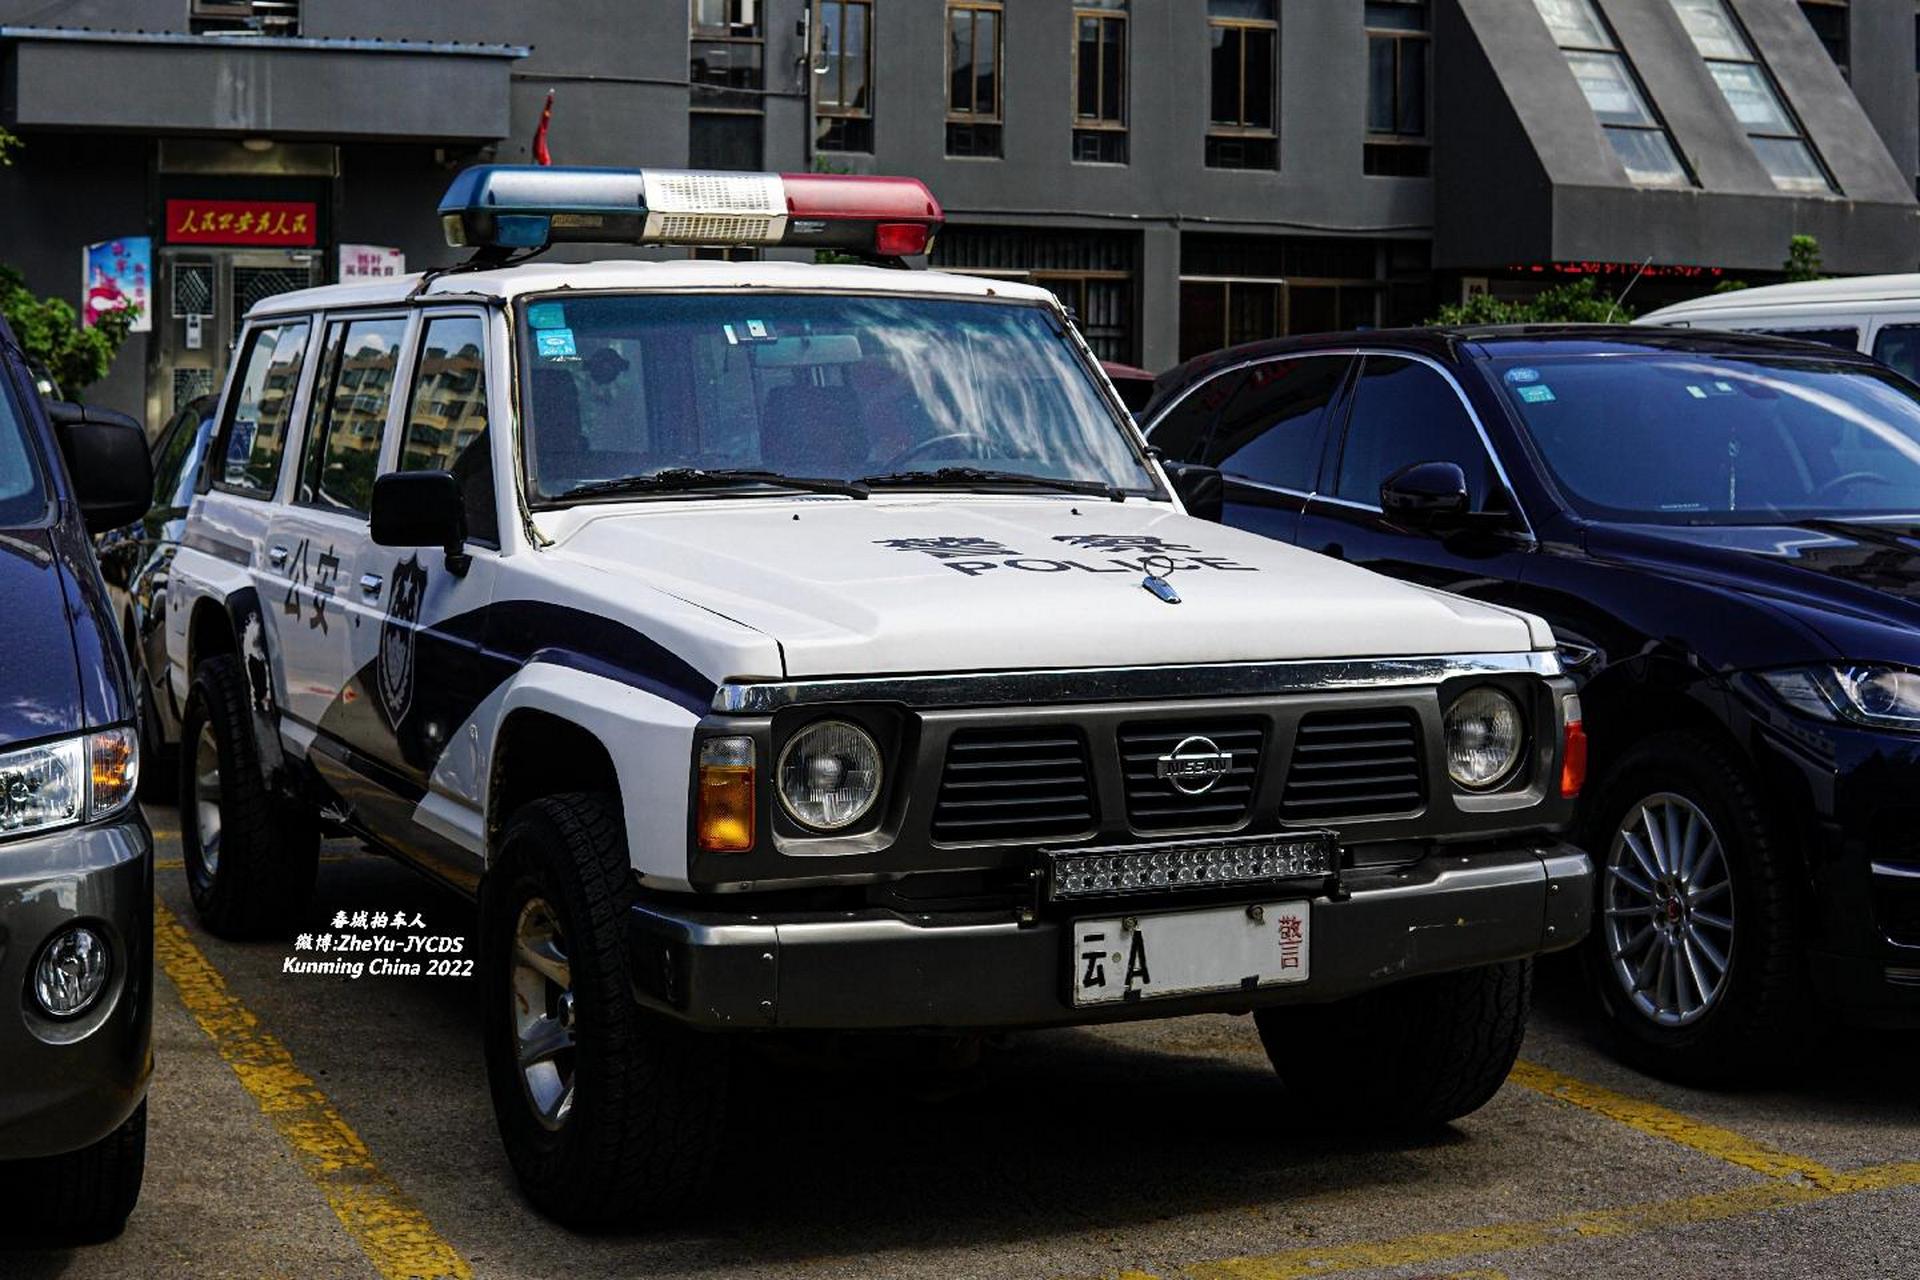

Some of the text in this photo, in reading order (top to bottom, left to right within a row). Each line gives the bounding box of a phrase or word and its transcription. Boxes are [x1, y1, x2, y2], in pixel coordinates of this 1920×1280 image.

[944, 555, 1260, 576] POLICE
[284, 538, 340, 637] 公安
[1166, 759, 1228, 776] NISSAN
[1081, 930, 1150, 989] 云A
